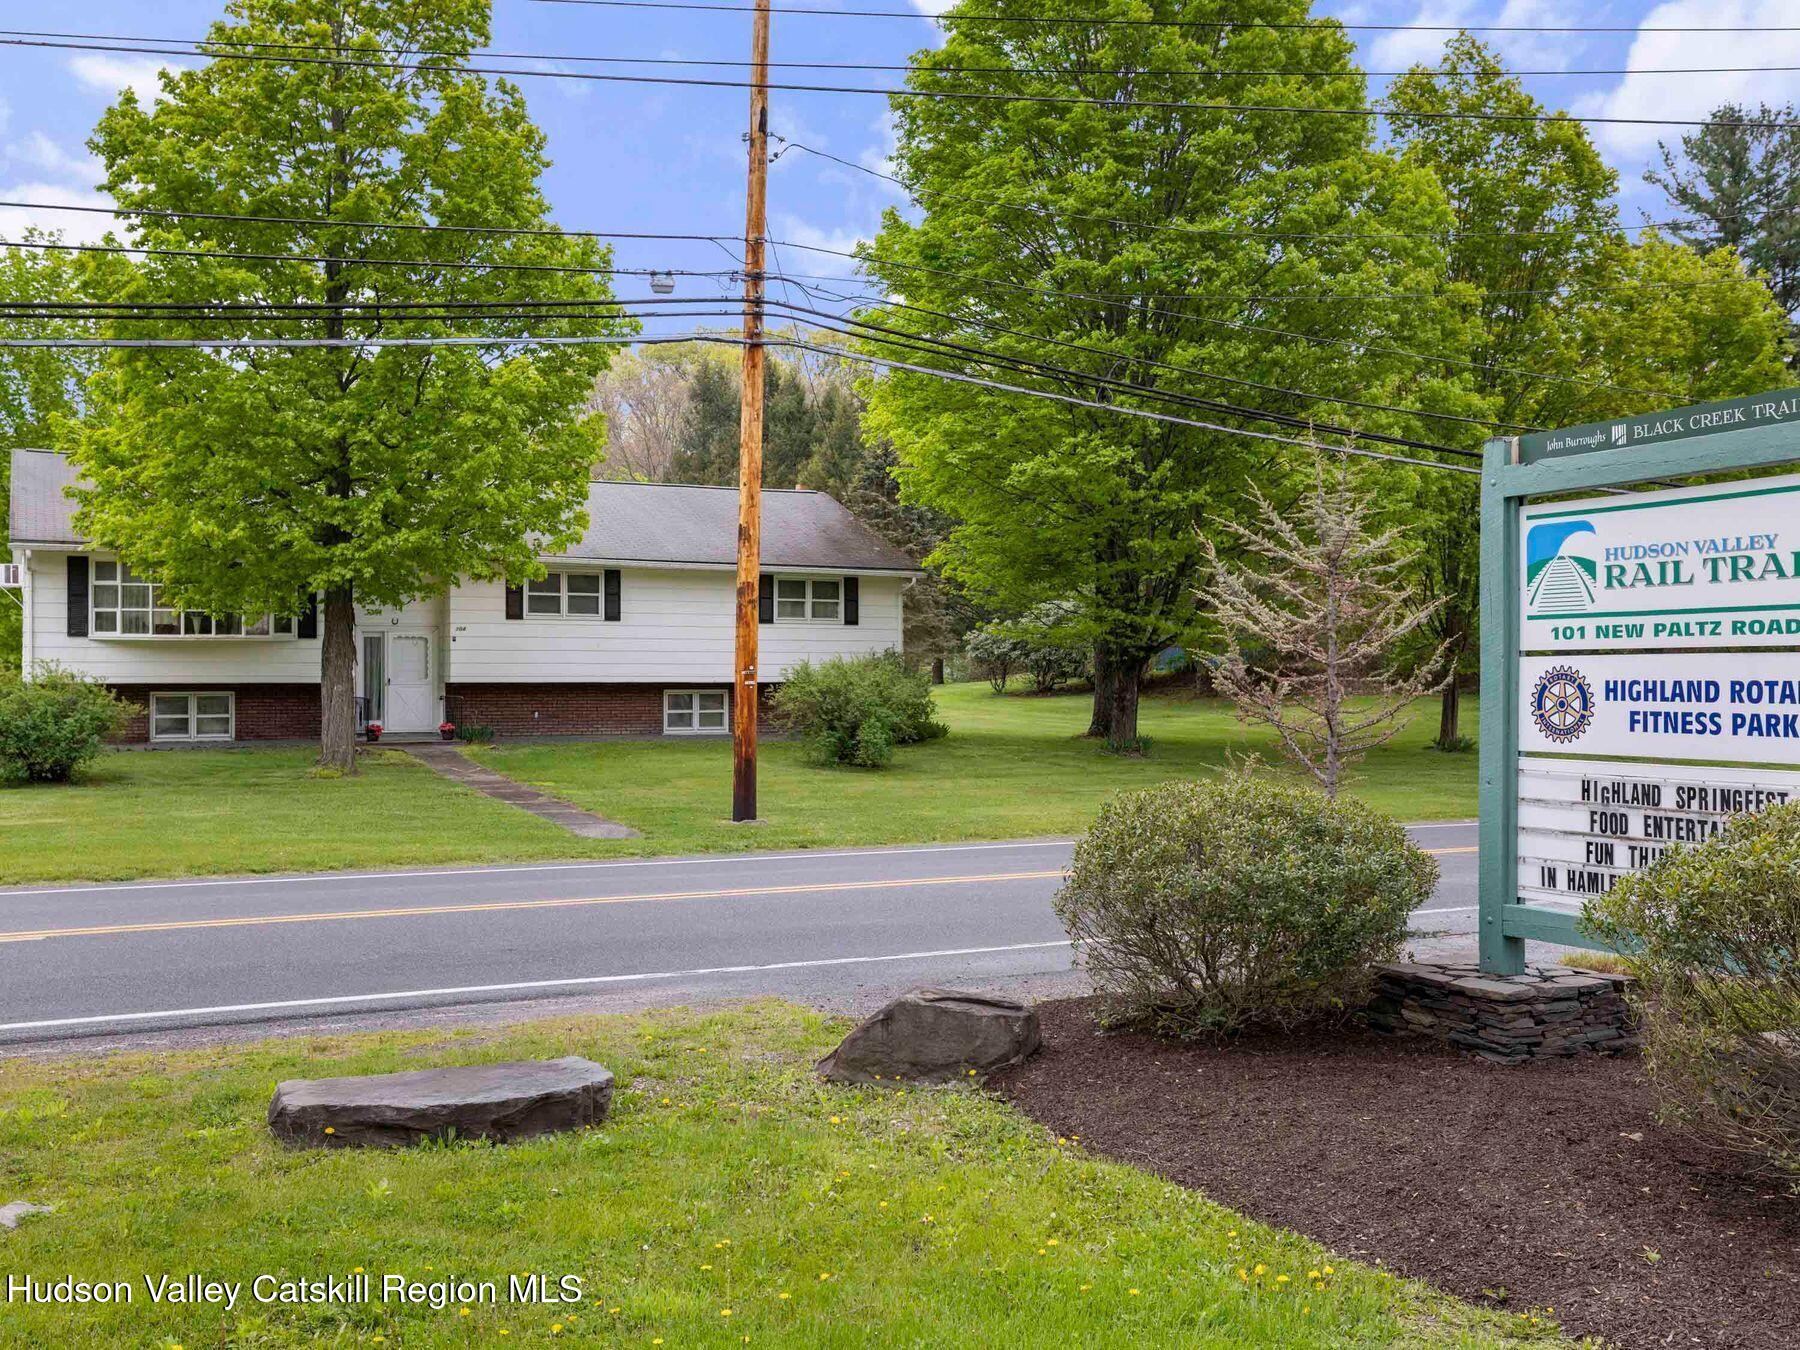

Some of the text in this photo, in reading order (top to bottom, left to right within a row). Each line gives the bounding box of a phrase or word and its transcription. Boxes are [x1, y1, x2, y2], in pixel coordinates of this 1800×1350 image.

[1633, 398, 1800, 439] BLACK CREEK TRAI
[1547, 430, 1606, 452] John Burroughs
[1605, 534, 1779, 561] HUDSON VALLEY
[1604, 559, 1695, 590] RAIL
[1551, 618, 1800, 640] 101 NEW PALTZ ROAD
[1605, 680, 1800, 704] HIGHLAND ROTA
[1629, 711, 1799, 738] FITNESS PARK
[1590, 811, 1628, 835] FOOD
[1586, 841, 1613, 865] FUN
[1541, 866, 1621, 894] IN HAMLE
